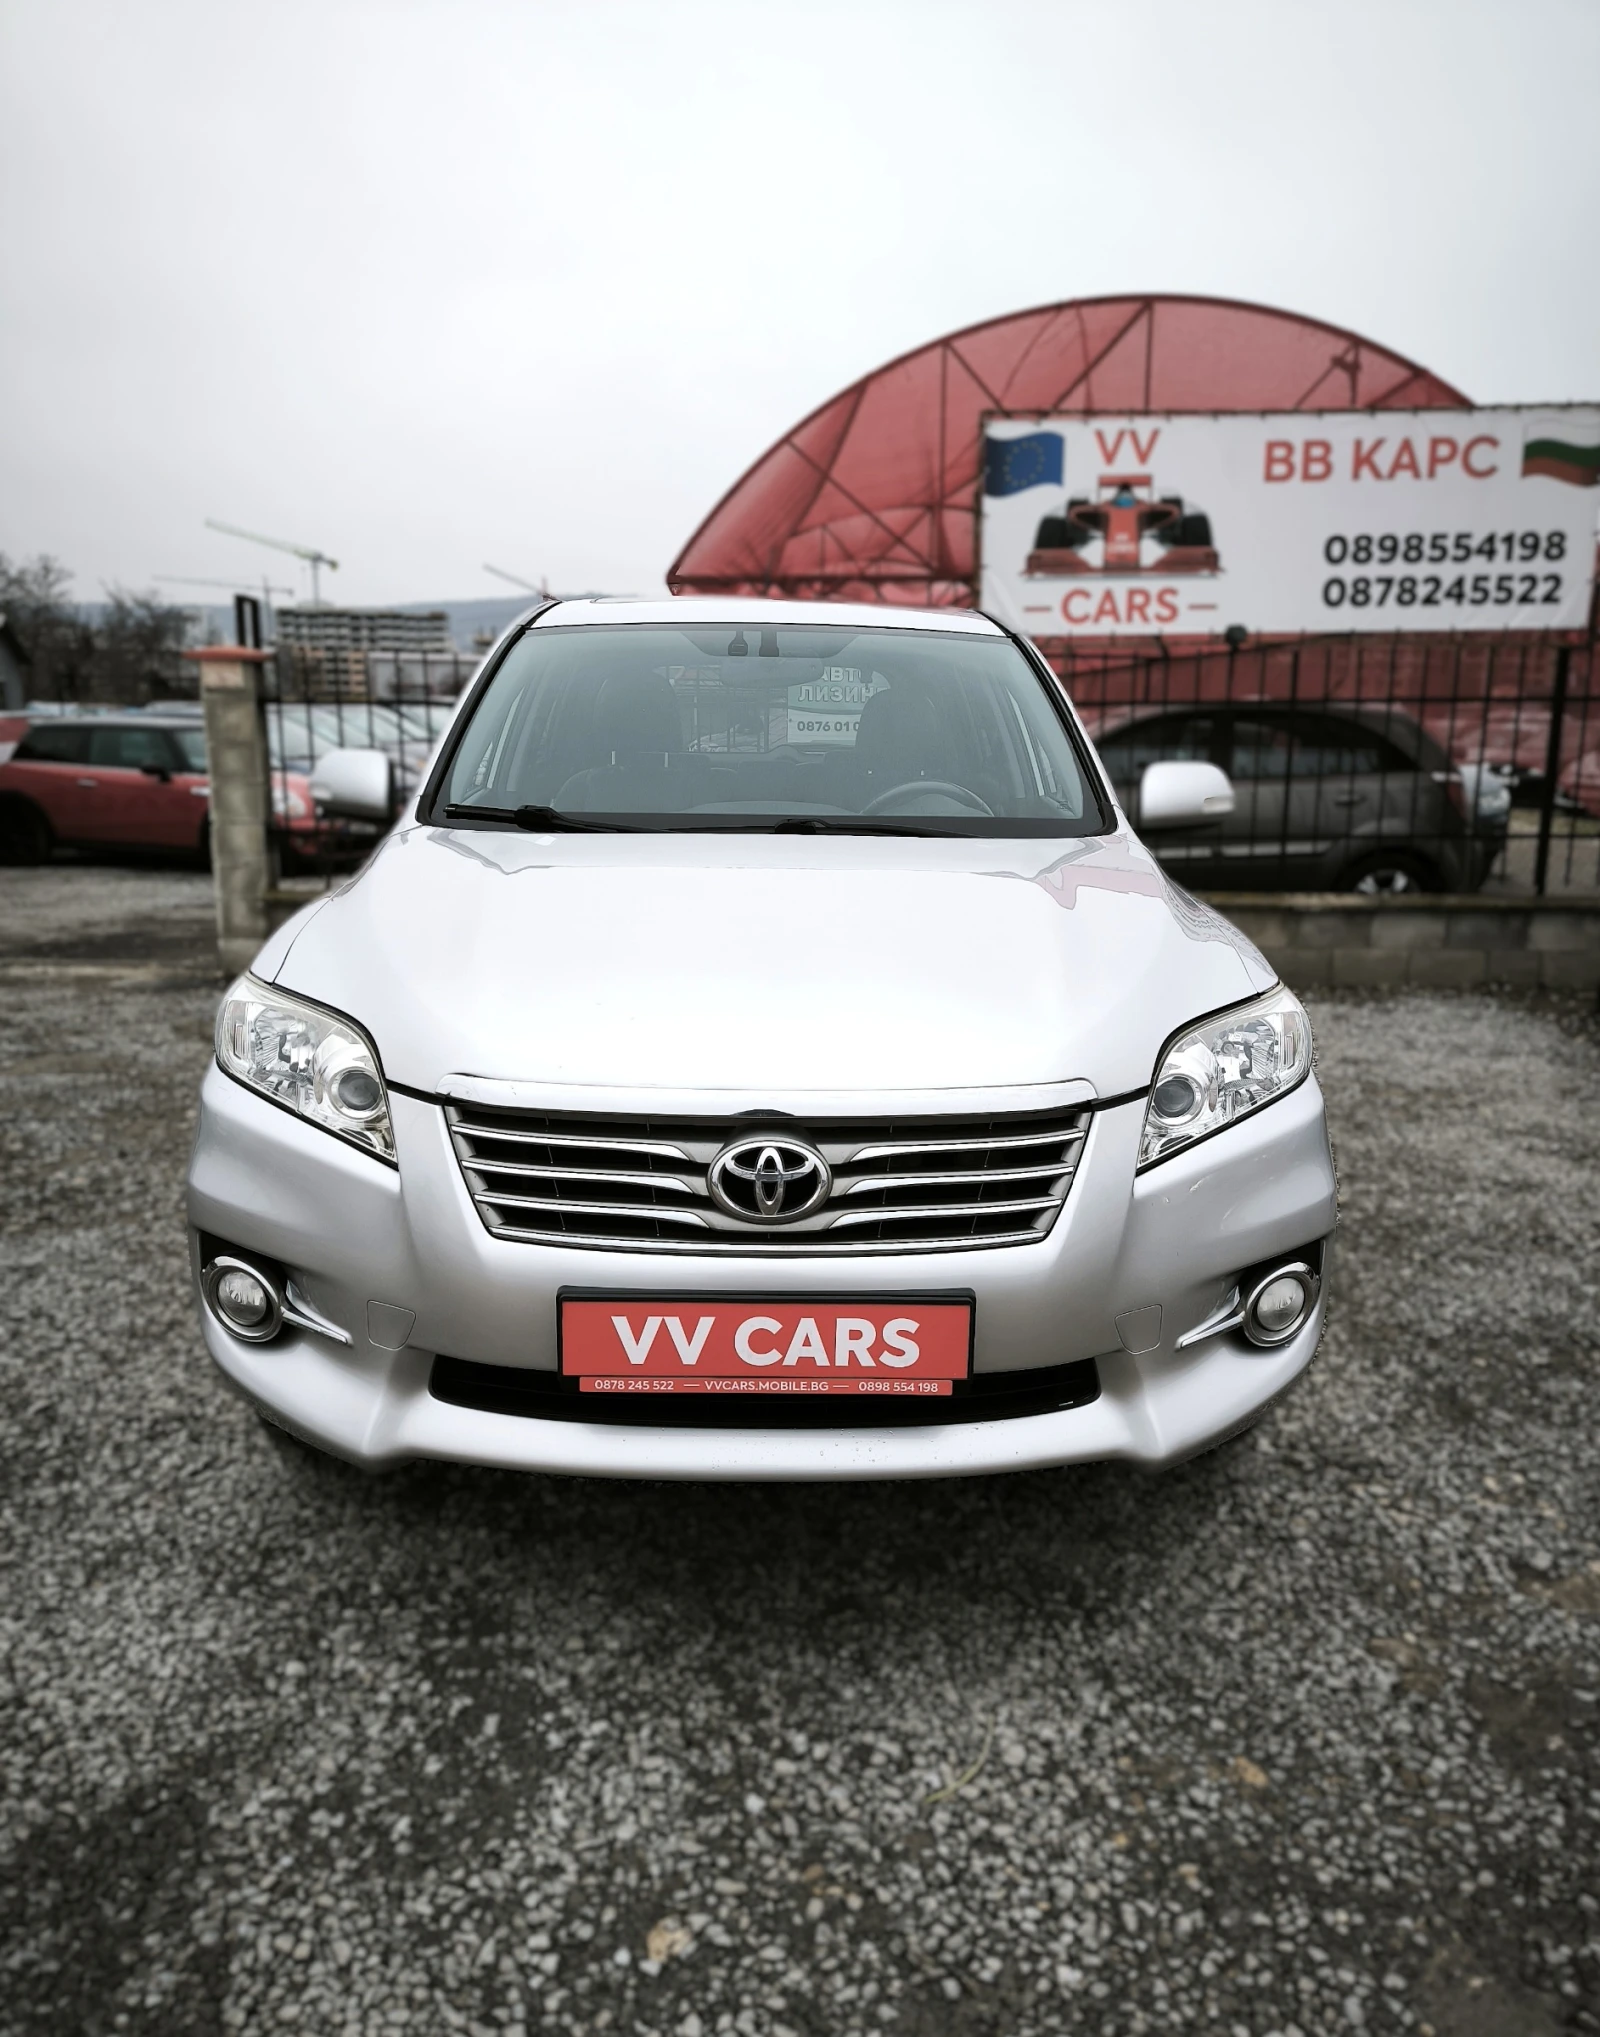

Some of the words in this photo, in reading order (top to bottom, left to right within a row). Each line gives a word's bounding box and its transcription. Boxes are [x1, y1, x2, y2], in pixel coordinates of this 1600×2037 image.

[1095, 429, 1161, 465] VV
[1263, 440, 1333, 482] ВВ
[1352, 435, 1500, 479] КАРС
[1324, 531, 1568, 565] 0898554198
[1061, 588, 1179, 623] CARS
[1322, 574, 1562, 608] 0878245522
[798, 685, 888, 703] ЛИЗИН
[797, 721, 831, 732] 0876
[834, 721, 850, 732] 01
[611, 1316, 716, 1365] VV
[734, 1316, 921, 1368] CARS
[594, 1380, 625, 1390] 0878
[628, 1381, 650, 1390] 245
[652, 1381, 674, 1390] 522
[704, 1381, 829, 1391] VVCARS.MOBILE.BG
[858, 1382, 890, 1392] 0898
[893, 1383, 915, 1392] 554
[917, 1383, 939, 1393] 198
